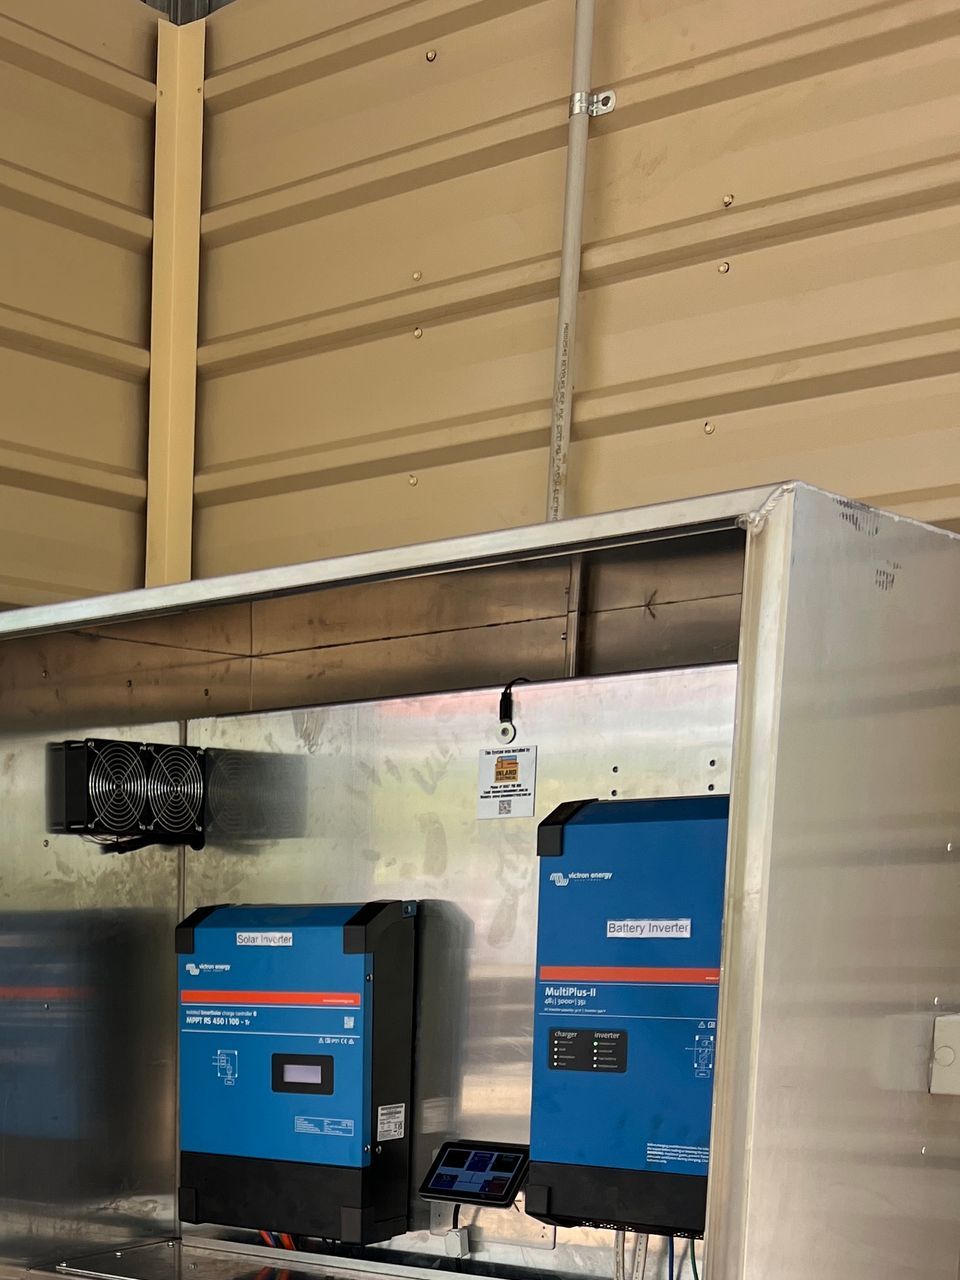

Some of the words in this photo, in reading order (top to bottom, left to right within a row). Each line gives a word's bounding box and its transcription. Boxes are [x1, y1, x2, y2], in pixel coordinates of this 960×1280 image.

[590, 872, 612, 880] energy
[608, 922, 645, 936] Battery
[648, 922, 689, 933] Inverter
[237, 934, 260, 944] Solar
[261, 934, 292, 944] Inverter
[545, 987, 596, 997] MultiPlus-II
[554, 1031, 578, 1039] charger
